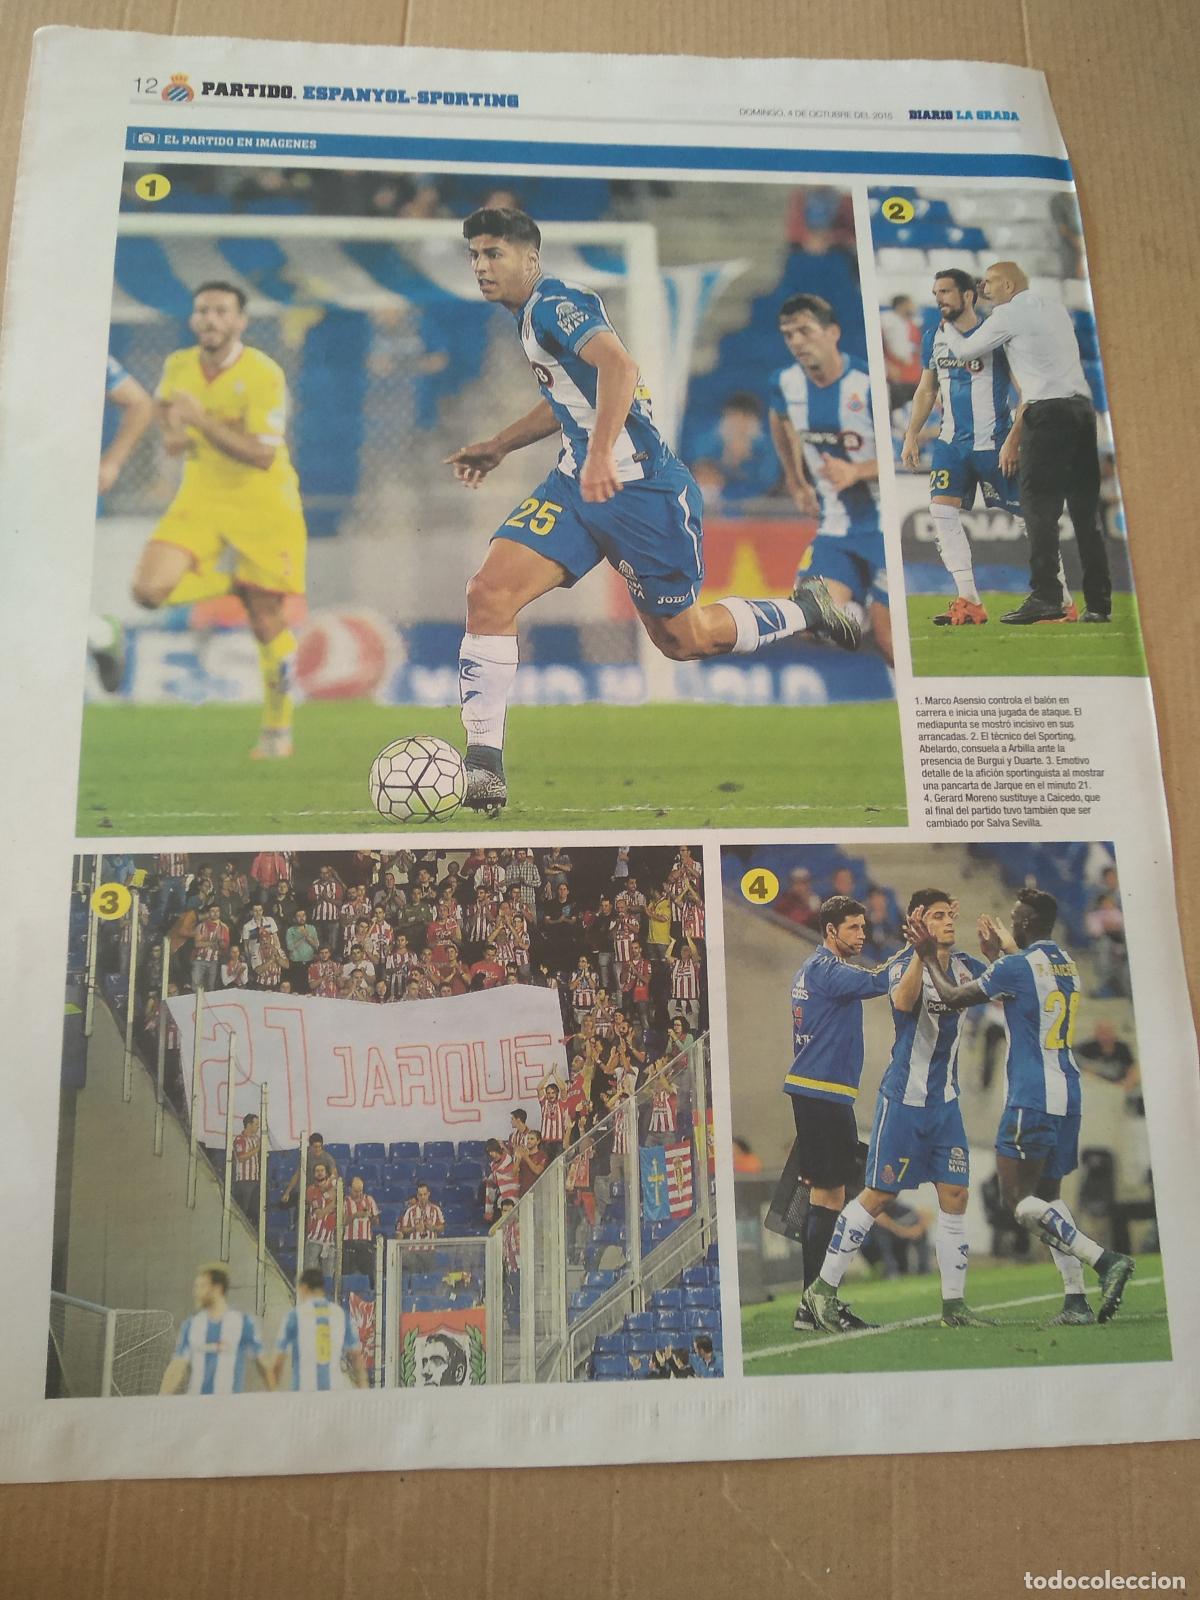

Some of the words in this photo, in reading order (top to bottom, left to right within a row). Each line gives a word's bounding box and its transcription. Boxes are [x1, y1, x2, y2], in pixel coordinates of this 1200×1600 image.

[134, 77, 158, 94] 12
[201, 82, 297, 99] PARTIDO.
[303, 86, 519, 108] ESPANYOL-SPORTING
[808, 110, 850, 118] OCTUBRE
[854, 111, 869, 119] DEL
[873, 112, 894, 120] 2015
[908, 110, 954, 120] DIARIO
[956, 110, 974, 120] LA
[976, 110, 1020, 121] GRADA
[164, 134, 180, 145] EL
[182, 136, 234, 147] PARTIDO
[236, 137, 253, 148] EN
[145, 179, 156, 197] 1
[888, 203, 906, 220] 2
[929, 470, 950, 492] 23
[504, 497, 563, 536] 25
[915, 696, 923, 705] 1.
[925, 696, 951, 705] Marco
[953, 696, 986, 705] Asensio
[988, 696, 1022, 704] controla
[1024, 696, 1032, 704] el
[1034, 696, 1057, 704] balón
[956, 708, 978, 717] inicia
[998, 708, 1027, 718] jugada
[1028, 708, 1040, 716] de
[1041, 708, 1072, 718] ataque.
[1074, 708, 1082, 716] El
[917, 720, 967, 730] mediapunta
[982, 720, 1011, 729] mostró
[1013, 720, 1045, 728] incisivo
[918, 732, 968, 741] arrancadas.
[970, 732, 978, 741] 2.
[981, 732, 989, 741] El
[991, 732, 1022, 741] técnico
[1024, 732, 1037, 740] del
[1038, 732, 1076, 742] Sporting,
[920, 744, 960, 754] Abelardo,
[961, 744, 999, 753] consuela
[1008, 744, 1035, 753] Arbilla
[1037, 744, 1056, 753] ante
[1057, 744, 1065, 753] la
[920, 757, 962, 766] presencia
[964, 756, 975, 765] de
[977, 756, 1005, 766] Burgui
[1014, 756, 1044, 765] Duarte.
[1046, 756, 1054, 765] 3.
[1056, 756, 1090, 765] Emotivo
[922, 769, 950, 778] detalle
[953, 769, 964, 777] de
[966, 768, 973, 777] la
[975, 768, 1004, 777] afición
[1006, 768, 1060, 779] sportinguista
[1062, 768, 1070, 777] al
[1072, 769, 1104, 777] mostrar
[941, 782, 979, 792] pancarta
[981, 781, 992, 790] de
[993, 781, 1023, 791] Jarque
[1037, 781, 1044, 789] el
[1047, 781, 1076, 790] minuto
[1078, 781, 1092, 790] 21.
[924, 794, 932, 803] 4.
[934, 794, 963, 803] Gerard
[966, 794, 997, 802] Moreno
[999, 794, 1038, 804] sustituye
[1047, 793, 1083, 803] Caicedo,
[1084, 795, 1101, 803] que
[925, 806, 933, 815] al
[935, 806, 954, 815] final
[956, 806, 969, 815] del
[971, 806, 1001, 817] partido
[1023, 806, 1058, 815] también
[1060, 807, 1076, 816] que
[926, 818, 968, 828] cambiado
[971, 820, 984, 829] por
[986, 818, 1010, 828] Salva
[1012, 818, 1042, 827] Sevilla.
[748, 876, 768, 899] 4
[99, 890, 120, 915] 3
[192, 1003, 310, 1140] 21
[327, 1034, 552, 1125] JARQUE
[898, 1158, 910, 1182] 7
